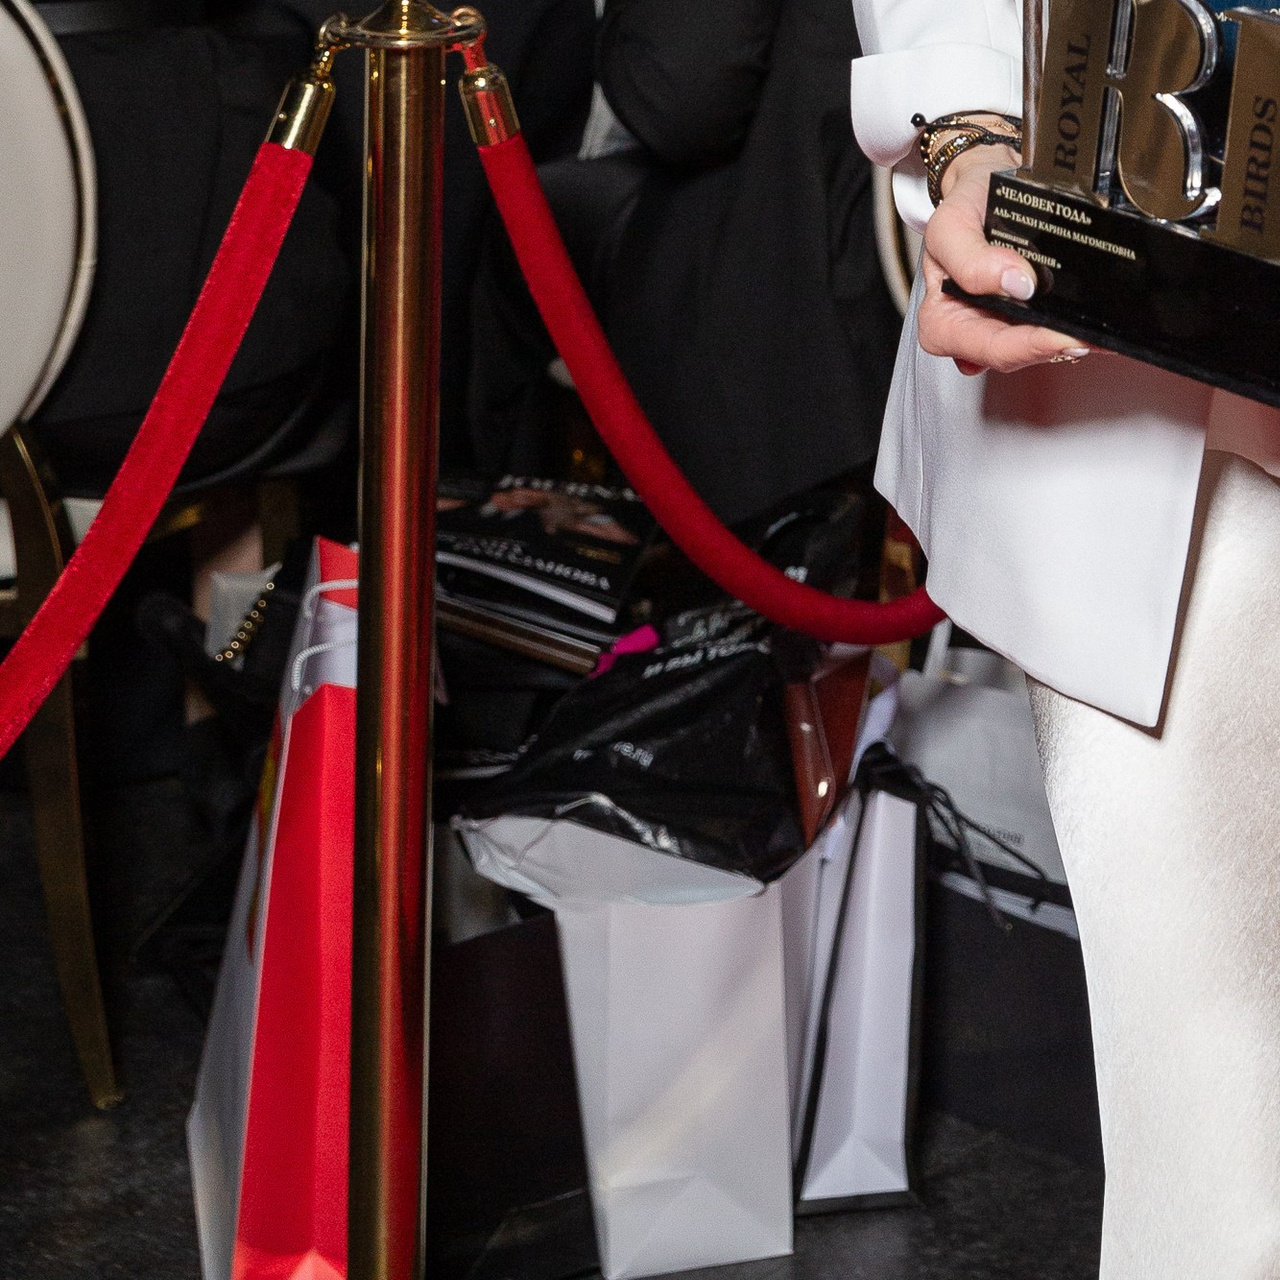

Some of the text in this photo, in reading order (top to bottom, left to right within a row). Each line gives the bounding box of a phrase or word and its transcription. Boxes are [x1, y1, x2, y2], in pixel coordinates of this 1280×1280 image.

[1054, 34, 1092, 174] ROYAL
[995, 185, 1092, 226] «ЧЕЛОВЕК ГОДА»
[1240, 95, 1278, 235] BIRDS
[1038, 220, 1072, 239] КАРИНА
[1072, 231, 1136, 261] МАГОМЕТОВНА
